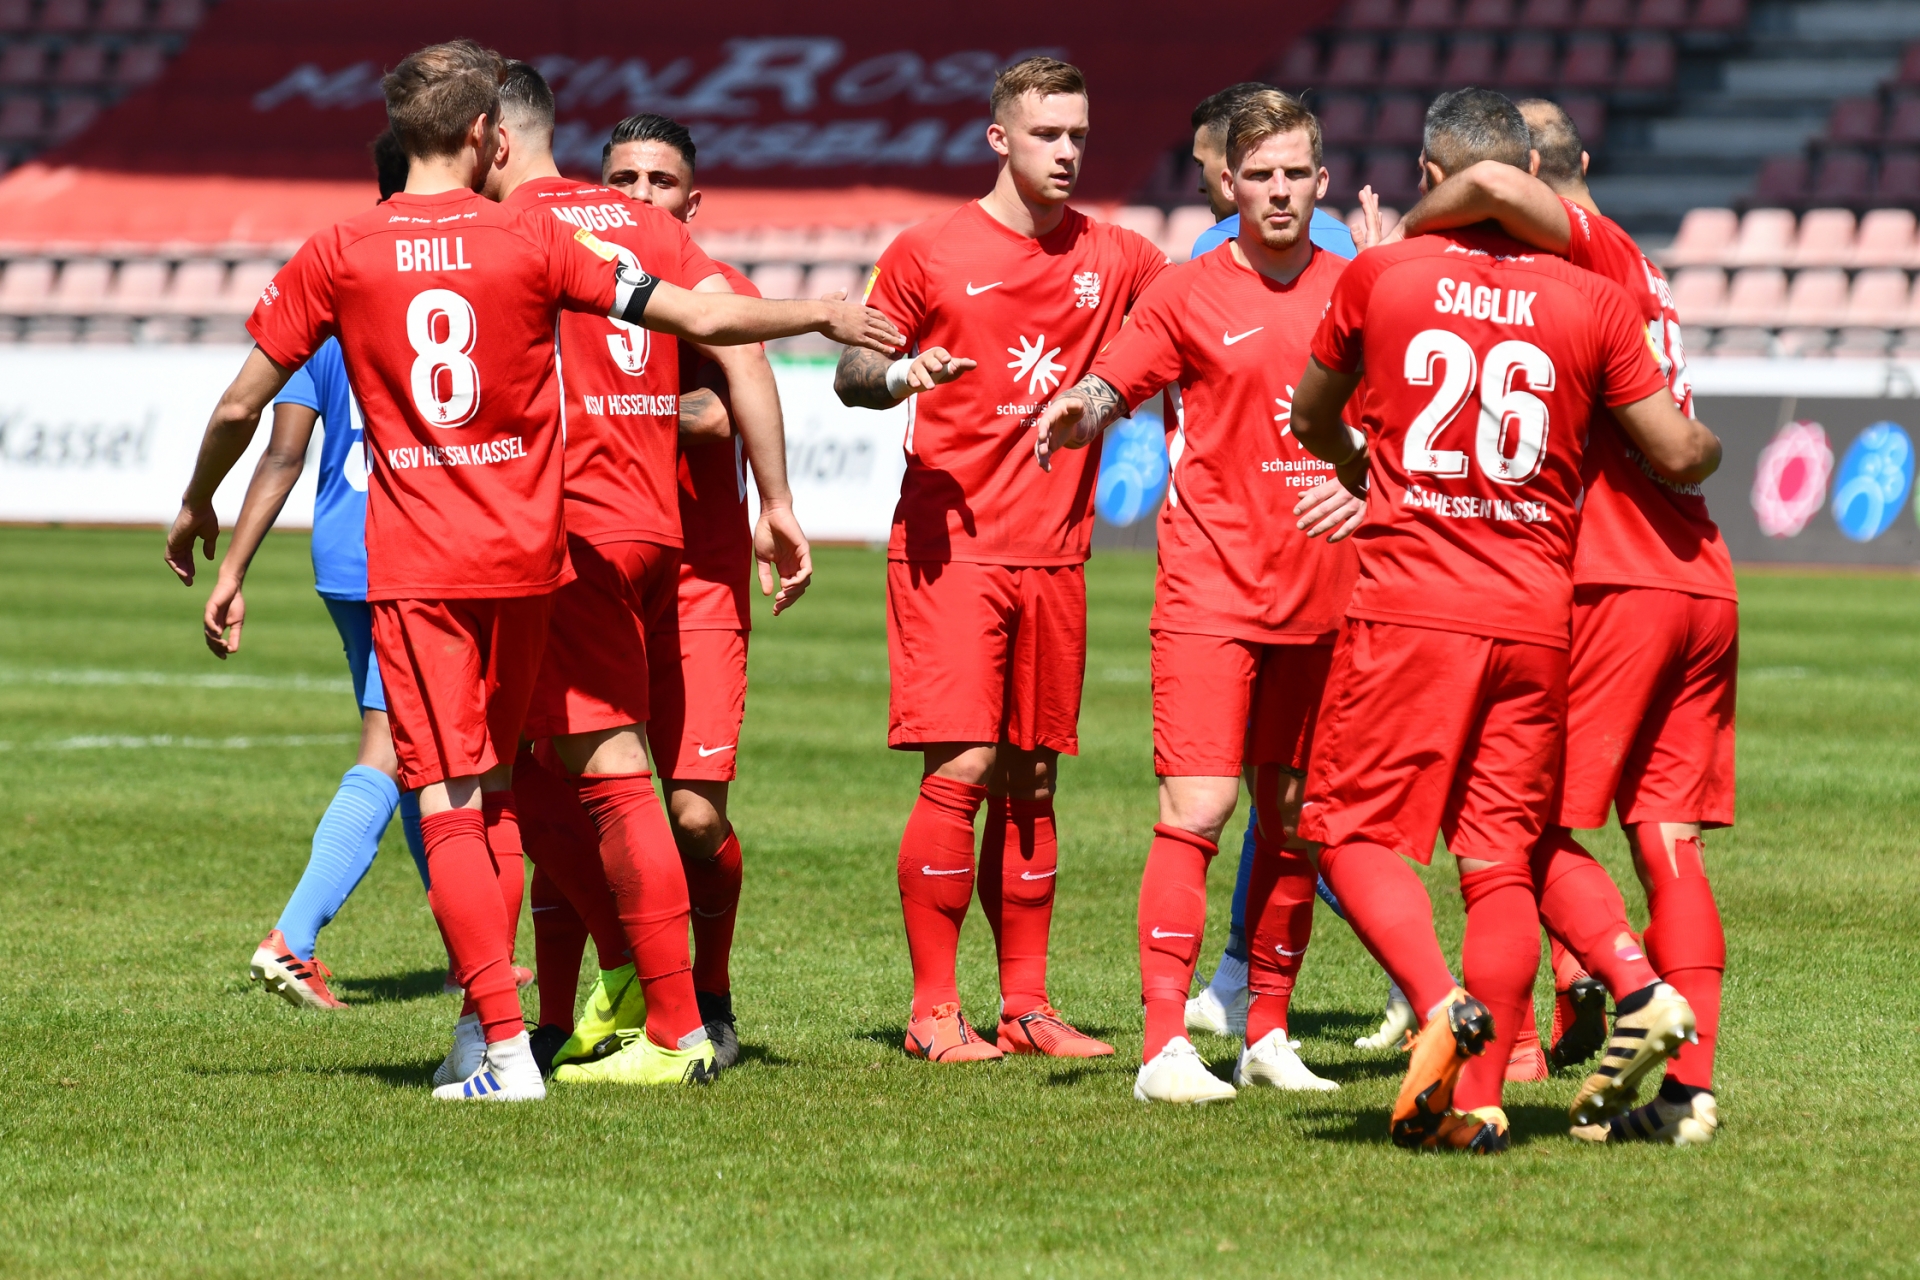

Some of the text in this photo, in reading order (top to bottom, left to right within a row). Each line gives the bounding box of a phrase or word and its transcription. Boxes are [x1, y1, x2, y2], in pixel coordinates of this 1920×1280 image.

[551, 203, 638, 232] MOGGE
[395, 236, 472, 272] BRILL
[267, 281, 280, 300] OSE
[1434, 277, 1538, 326] SAGLIK
[406, 288, 481, 428] 8
[647, 394, 678, 416] ASSEL
[1402, 329, 1556, 487] 26
[388, 447, 419, 470] KSV
[470, 436, 527, 465] KASSEL
[1261, 456, 1336, 472] schauinsla
[1285, 472, 1327, 487] reisen
[1431, 491, 1492, 519] HESSEN
[1493, 499, 1552, 523] KASSEL
